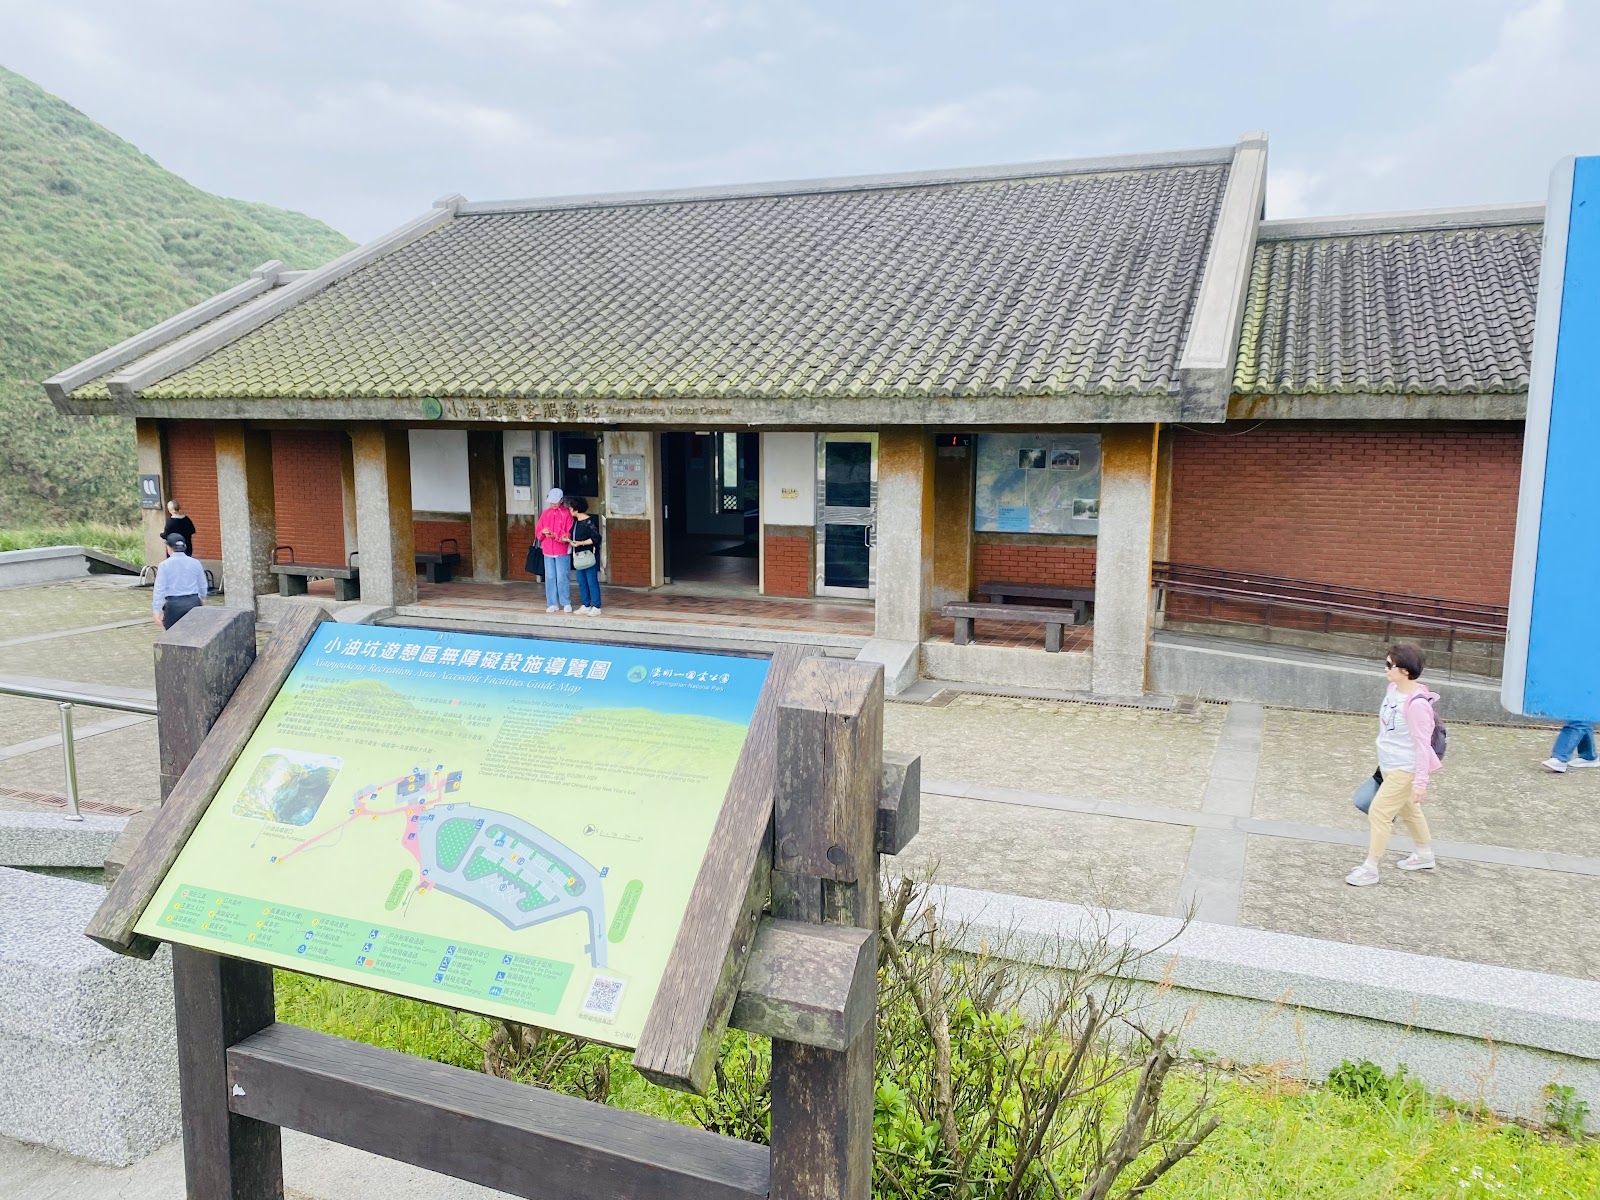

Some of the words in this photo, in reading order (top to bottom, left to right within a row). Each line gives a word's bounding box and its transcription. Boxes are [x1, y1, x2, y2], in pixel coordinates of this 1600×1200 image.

[448, 399, 600, 419] 小油坑遊客服務站
[605, 405, 666, 417] Xiaoyoukeng
[667, 405, 698, 415] Visitor
[700, 404, 732, 416] Center
[324, 637, 612, 681] 小油坑遊憩區無障礙設施導覽圖
[313, 658, 367, 675] Xiaoyoukeng
[368, 663, 413, 677] Recreation
[414, 668, 437, 679] Area
[439, 670, 483, 684] Accessible
[483, 674, 524, 688] Facilities
[526, 679, 556, 692] Guide
[557, 682, 582, 697] Map
[688, 683, 710, 691] National
